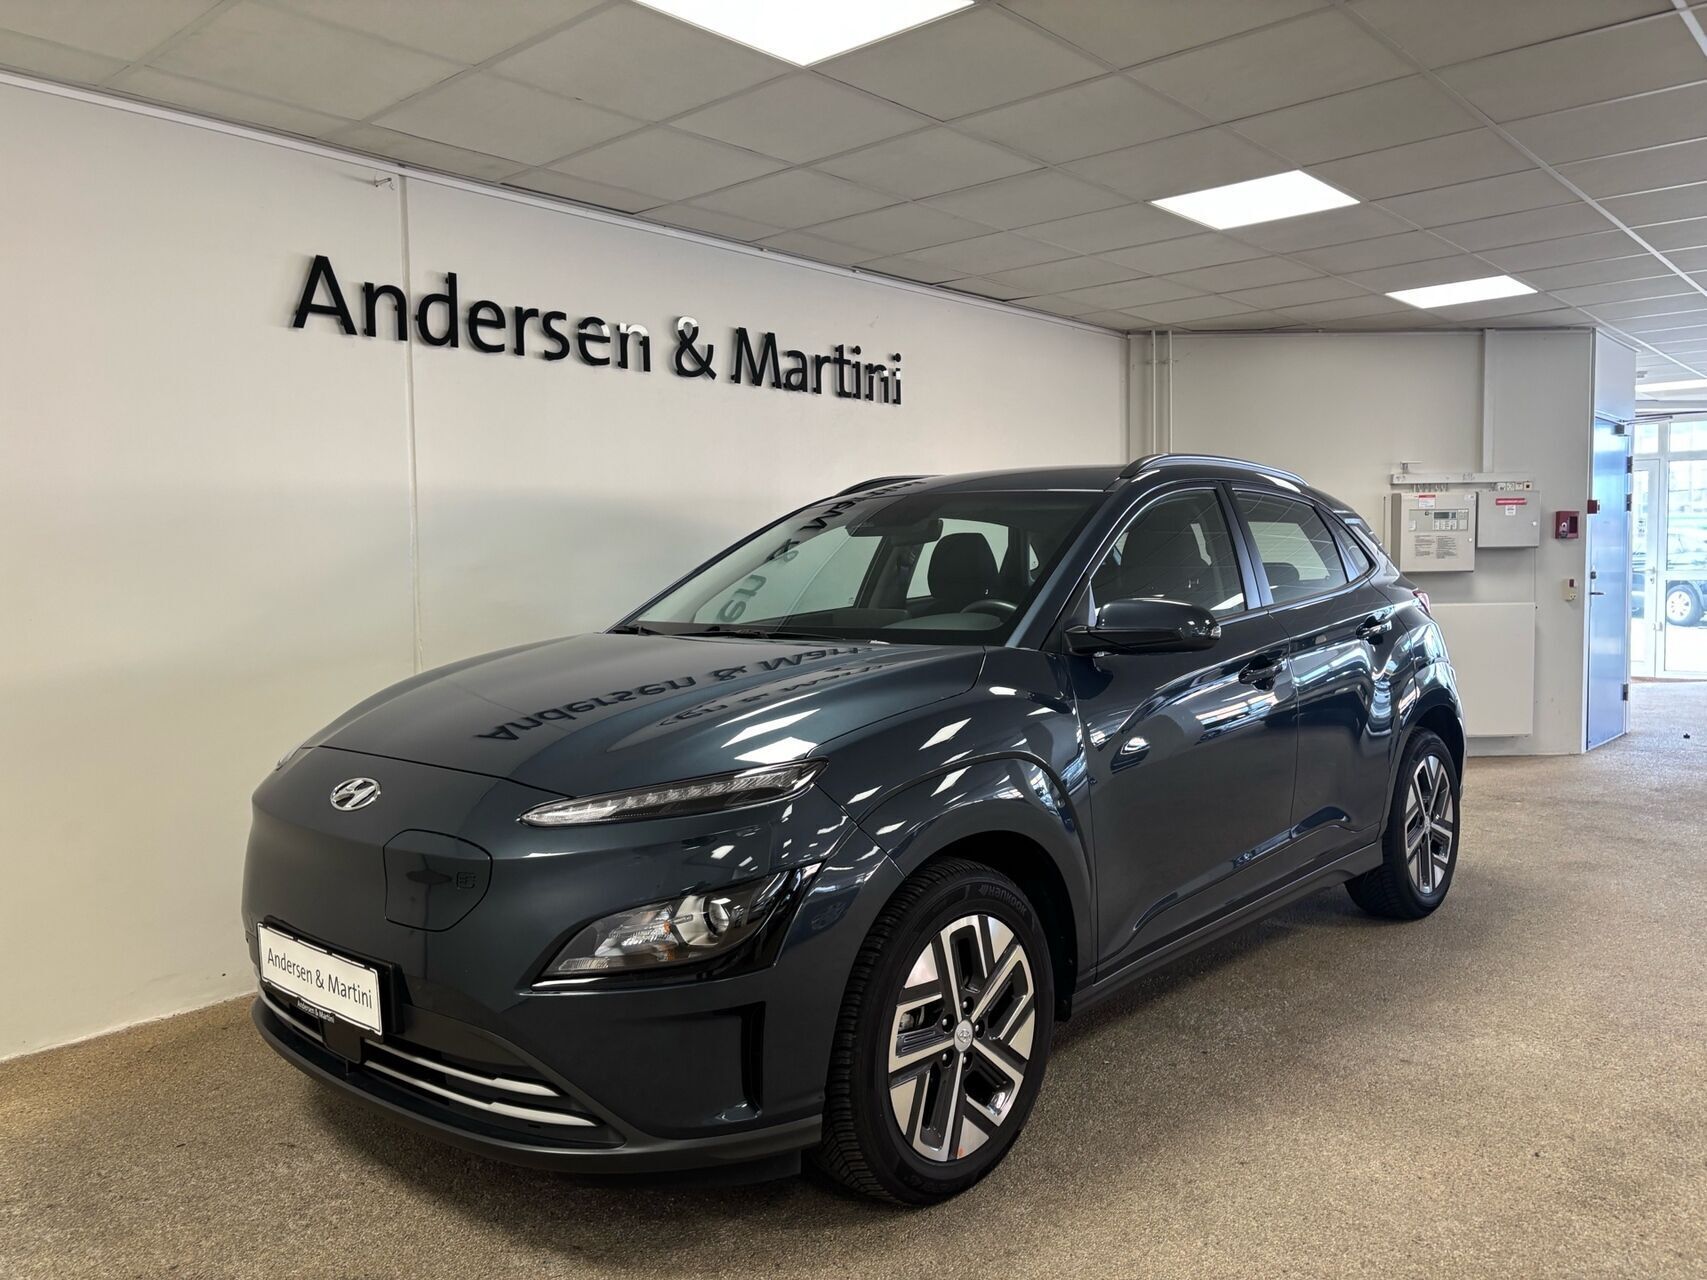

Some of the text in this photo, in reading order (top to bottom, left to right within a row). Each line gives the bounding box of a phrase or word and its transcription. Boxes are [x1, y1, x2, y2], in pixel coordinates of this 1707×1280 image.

[293, 255, 902, 404] Andersen & Martini
[268, 948, 373, 1010] Andersen & Martini
